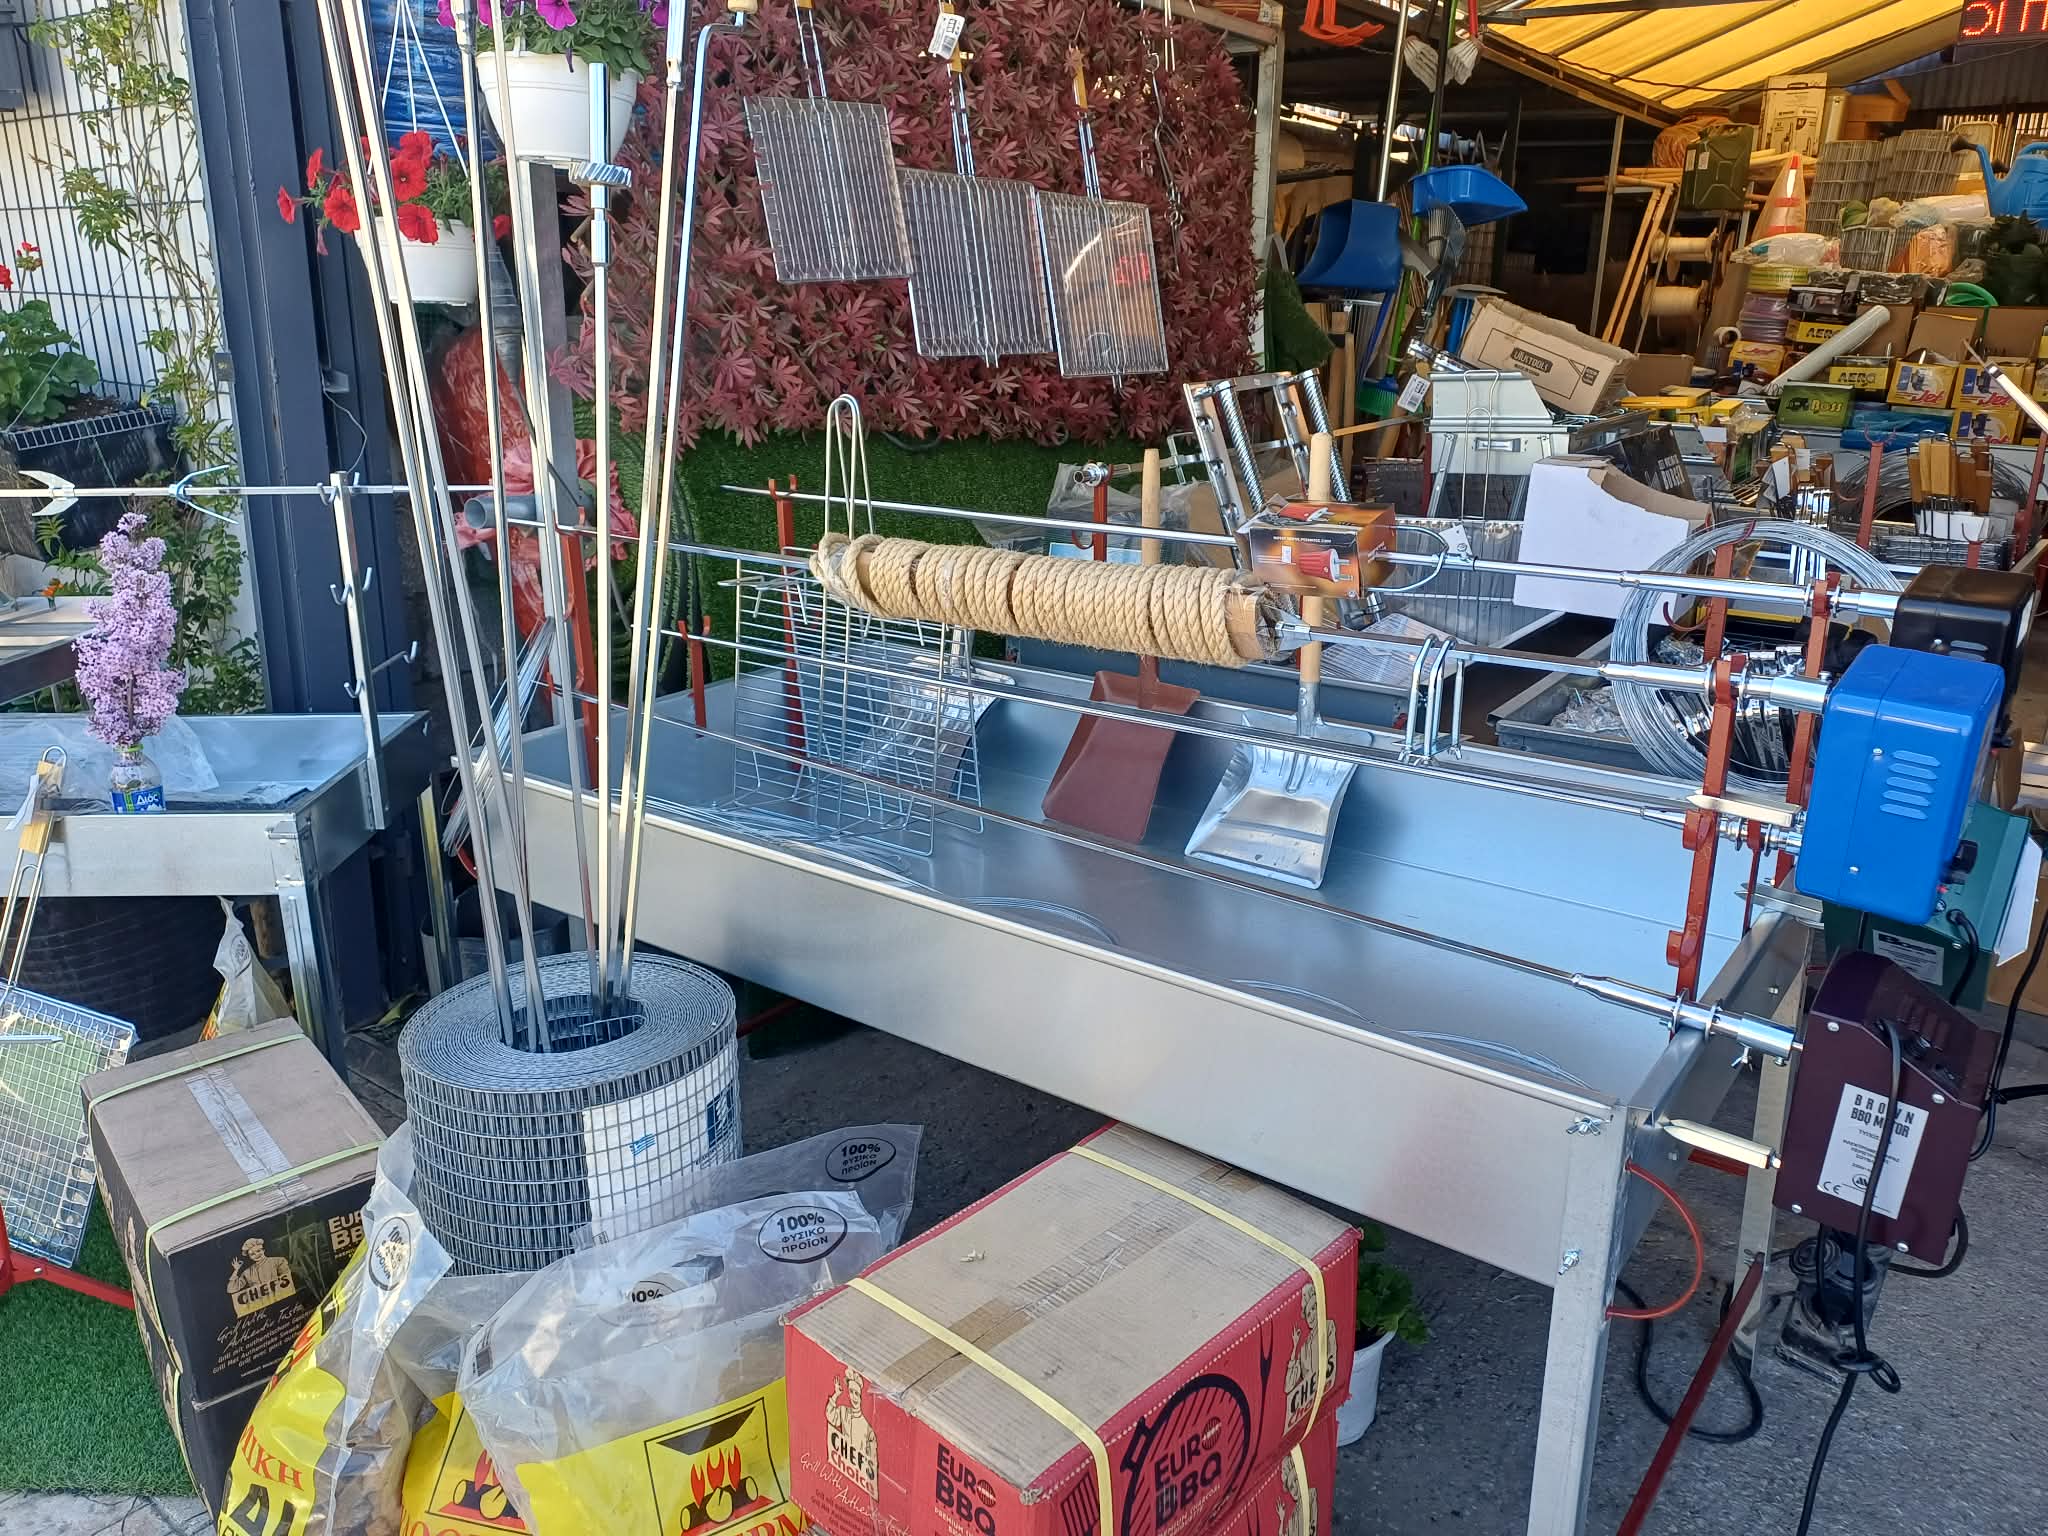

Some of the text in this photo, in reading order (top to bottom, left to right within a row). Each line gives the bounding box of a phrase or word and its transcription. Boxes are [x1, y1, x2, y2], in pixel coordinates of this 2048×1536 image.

[1806, 327, 1841, 340] AER
[1850, 1107, 1910, 1138] BBQ MTOR
[841, 1143, 881, 1158] 100%
[776, 1212, 825, 1233] 100%
[781, 1226, 826, 1244] ΦΥΣΙΚΟ
[237, 1275, 291, 1306] CHEF'S
[831, 1432, 875, 1481] CHEF'S
[935, 1470, 996, 1536] BBQ
[1155, 1451, 1222, 1530] BBQ
